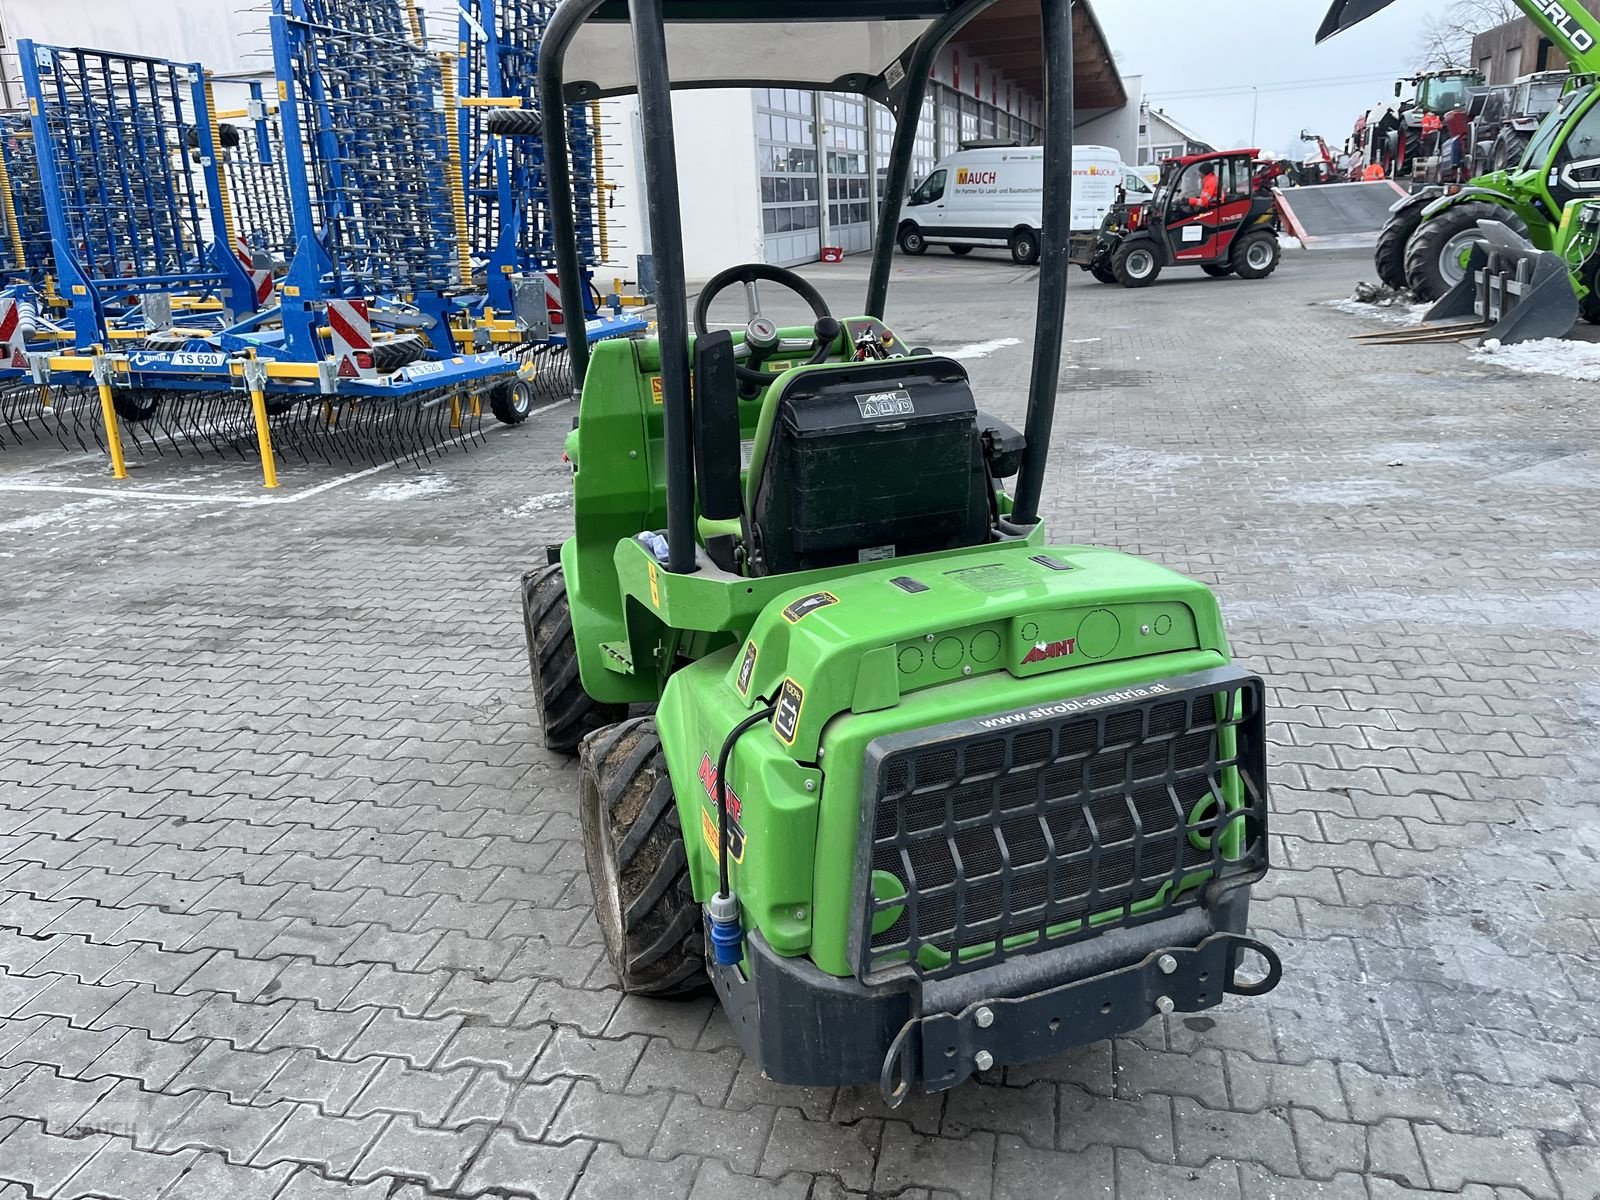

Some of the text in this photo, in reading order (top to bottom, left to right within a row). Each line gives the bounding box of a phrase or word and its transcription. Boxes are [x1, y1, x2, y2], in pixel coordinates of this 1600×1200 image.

[957, 171, 997, 185] MAUCH
[179, 354, 194, 364] TS
[197, 354, 218, 365] 620
[979, 682, 1171, 728] www.strobl-austria.at
